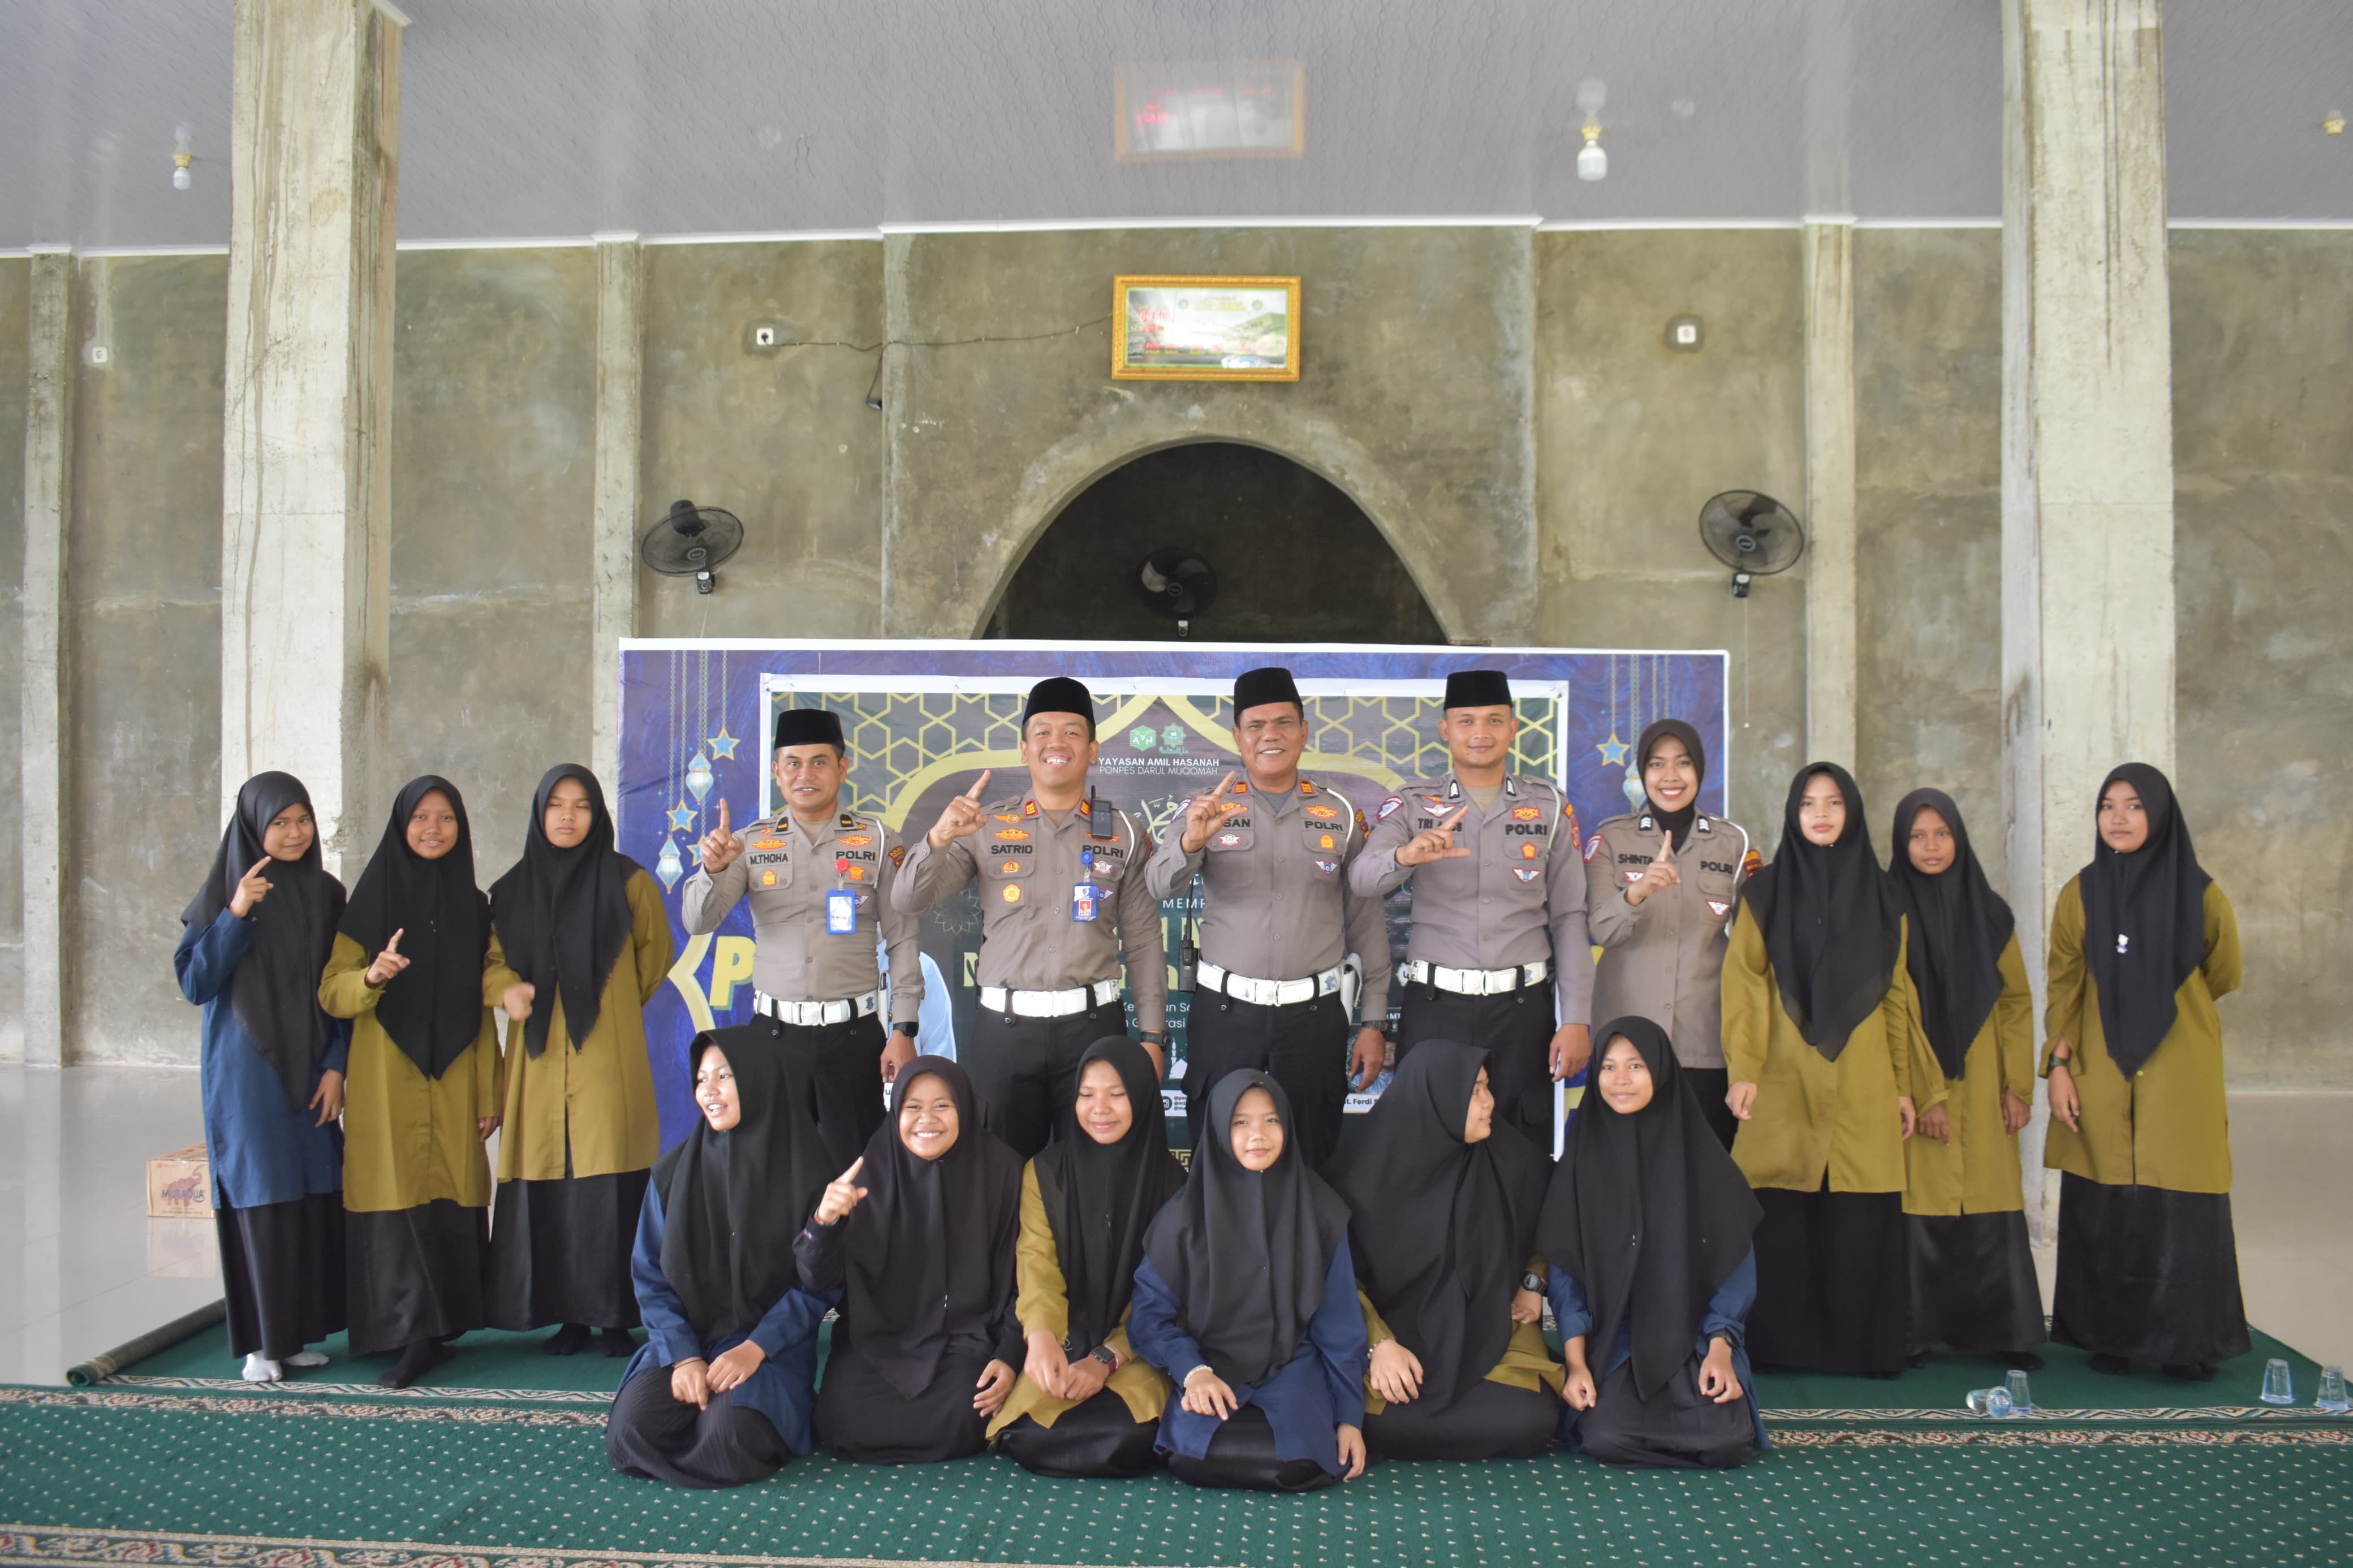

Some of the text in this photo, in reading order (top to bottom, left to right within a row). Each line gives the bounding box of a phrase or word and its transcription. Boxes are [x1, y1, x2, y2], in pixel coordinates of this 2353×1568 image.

[1223, 819, 1250, 828] SAN
[1305, 820, 1343, 831] POLRI
[1418, 818, 1433, 829] TRI
[1505, 823, 1547, 836] POLRI
[991, 845, 1033, 854] SATRIO
[1082, 844, 1123, 858] POLRI
[750, 853, 788, 865] M.THOHA
[836, 850, 875, 861] POLRI
[1618, 853, 1653, 865] SHINTA
[1701, 861, 1733, 874] POLRI
